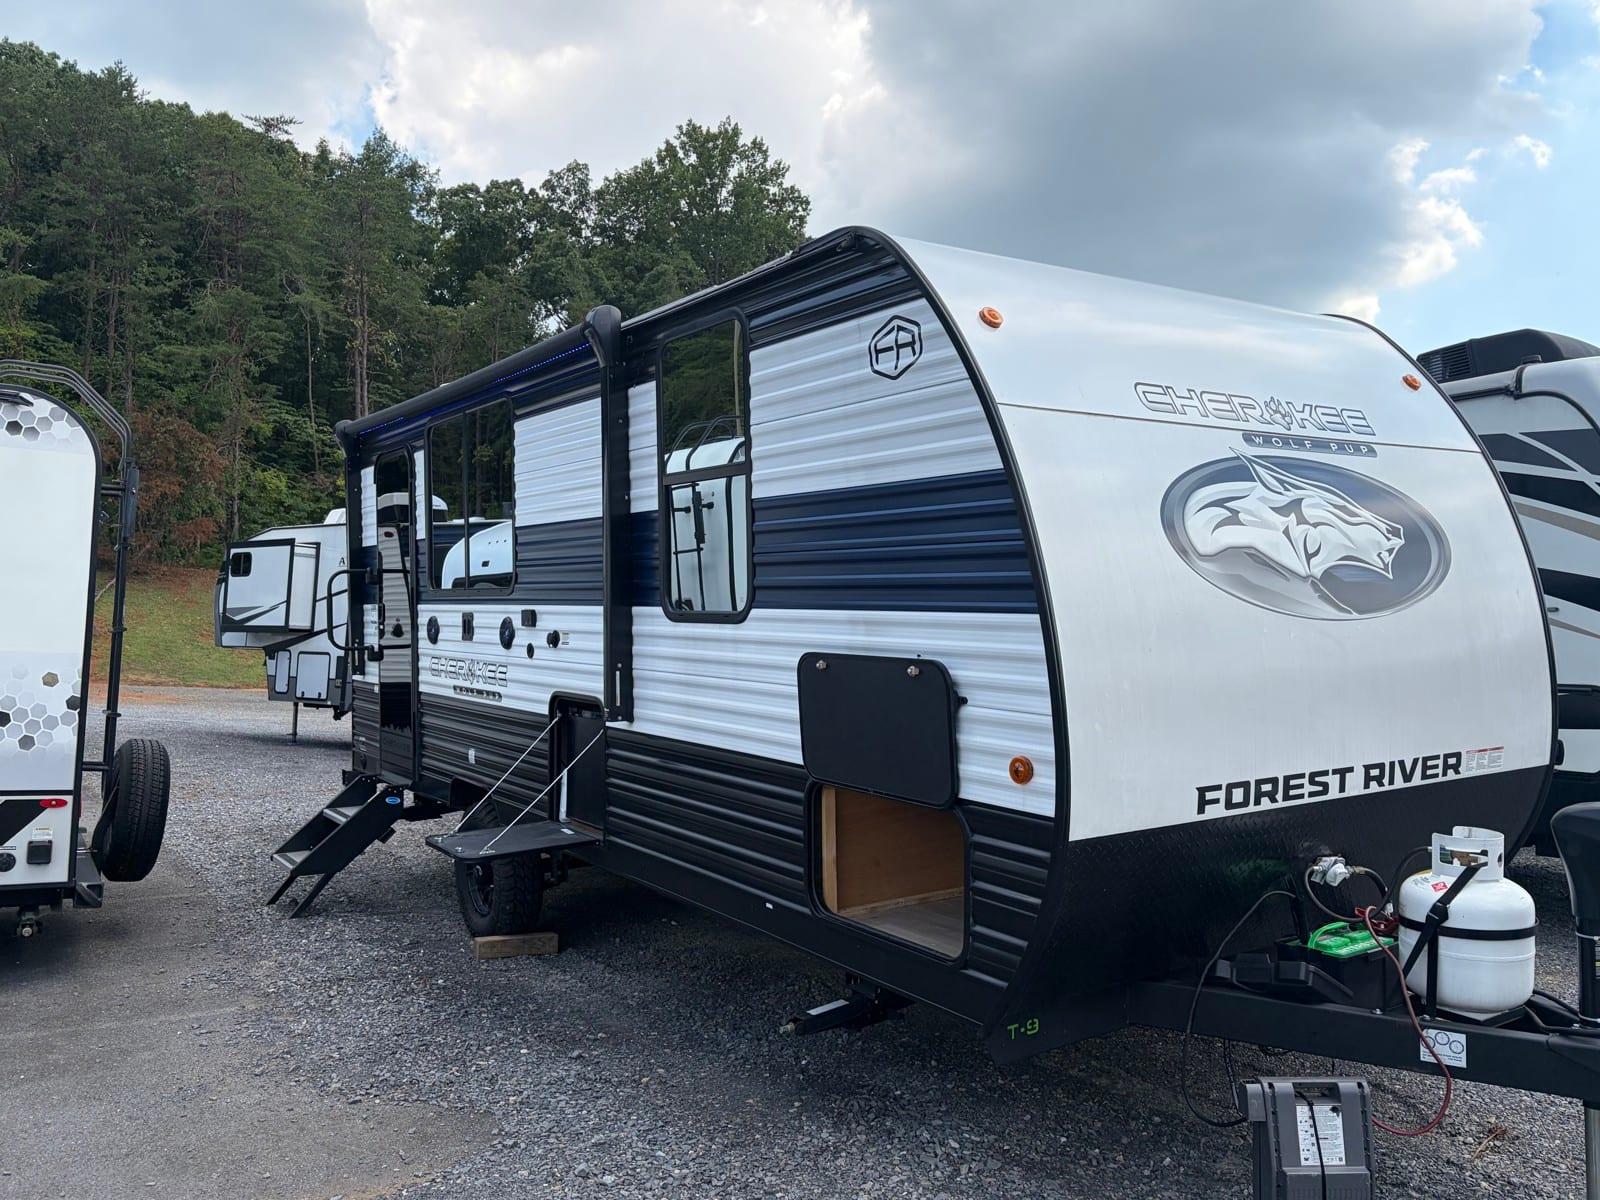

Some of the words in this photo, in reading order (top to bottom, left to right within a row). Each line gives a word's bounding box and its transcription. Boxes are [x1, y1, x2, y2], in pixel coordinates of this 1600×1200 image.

[1133, 382, 1376, 437] CHEROKEE
[1251, 434, 1314, 451] WOLF
[1329, 441, 1369, 455] PUP
[1195, 766, 1354, 815] FOREST
[1362, 751, 1462, 790] RIVER
